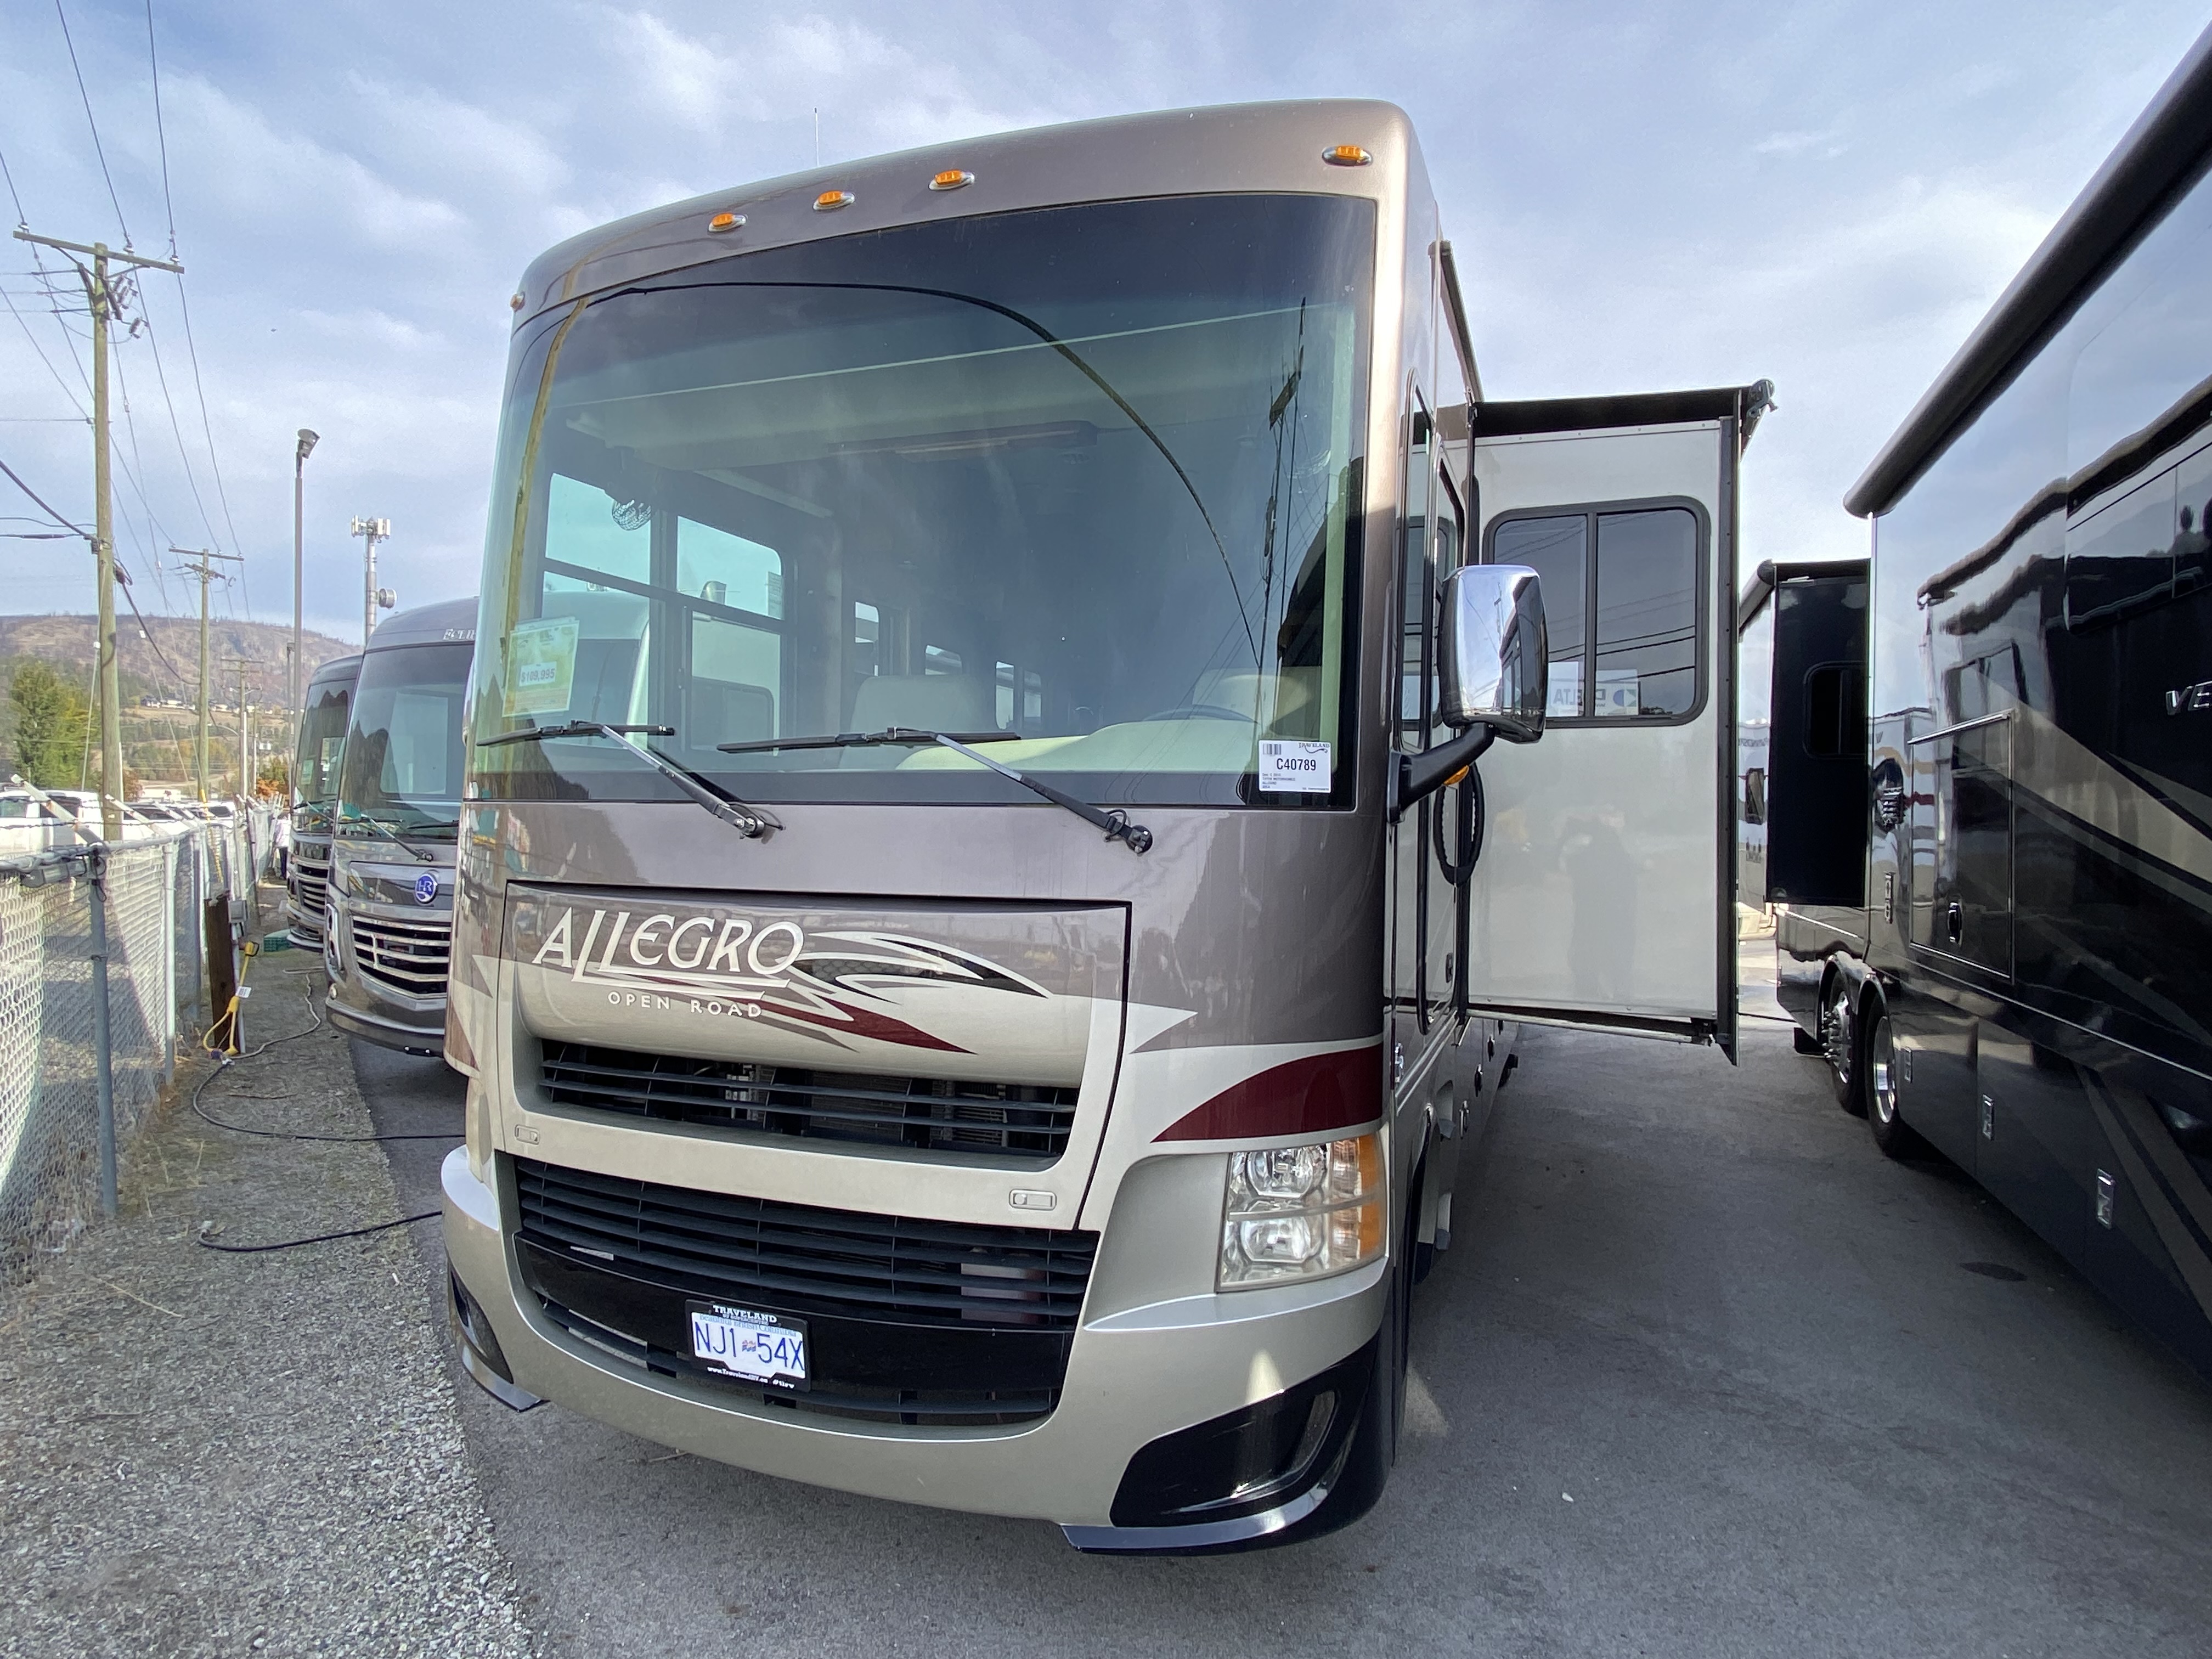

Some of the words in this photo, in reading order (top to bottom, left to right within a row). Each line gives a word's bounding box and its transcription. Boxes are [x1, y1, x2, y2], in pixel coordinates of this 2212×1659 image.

[521, 668, 556, 682] $109,995
[1277, 758, 1317, 771] C40789
[531, 906, 804, 1000] ALLEGRO
[608, 991, 671, 1010] OPEN
[690, 1002, 762, 1018] ROAD
[713, 1305, 777, 1323] TRAVELAND
[695, 1321, 737, 1358] NJ1
[757, 1332, 805, 1371] 54X
